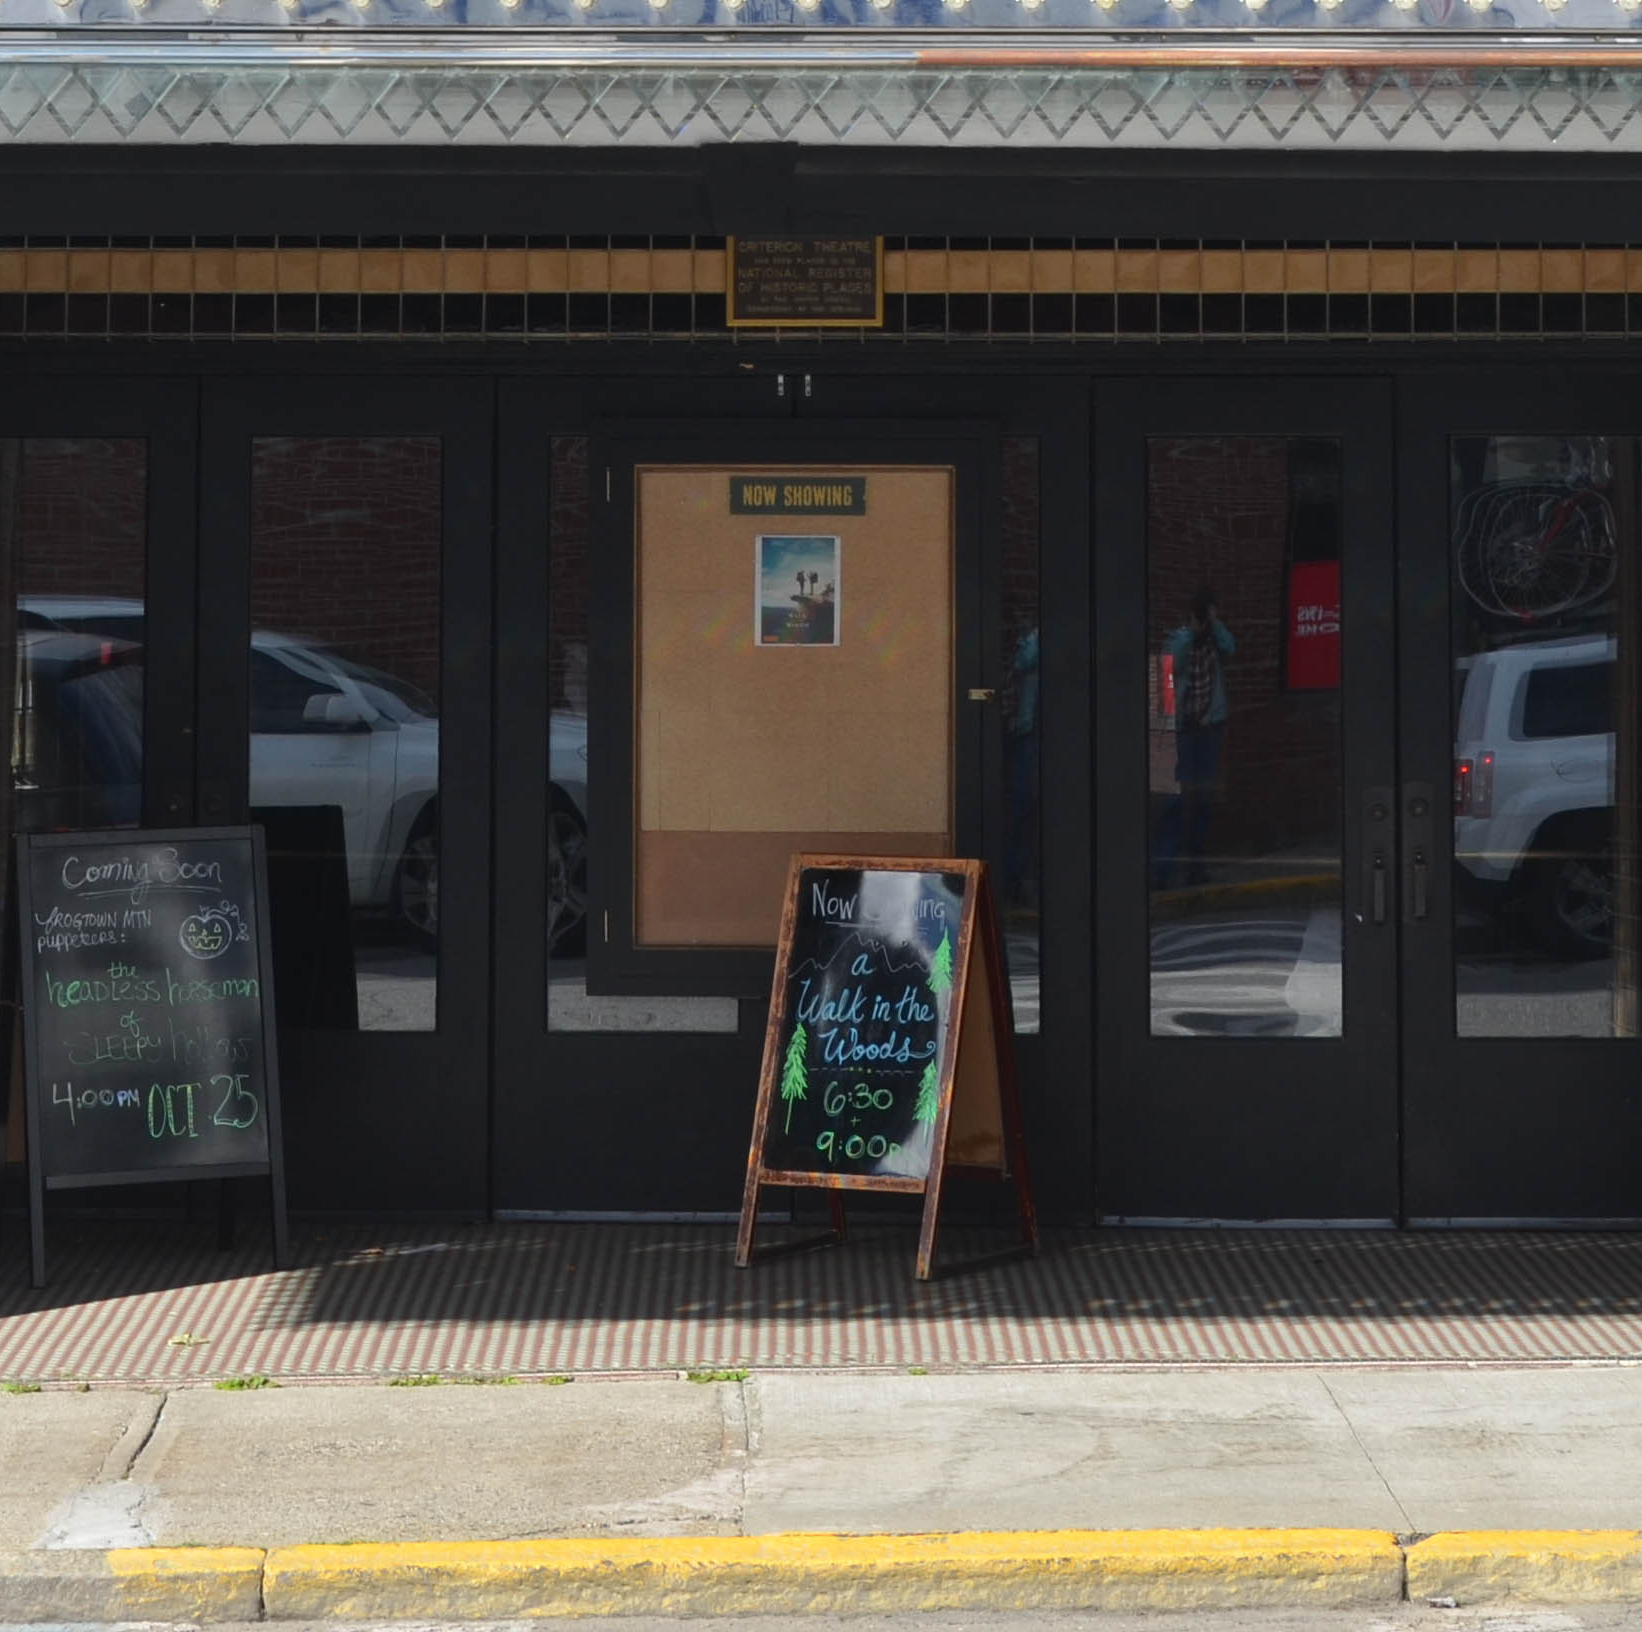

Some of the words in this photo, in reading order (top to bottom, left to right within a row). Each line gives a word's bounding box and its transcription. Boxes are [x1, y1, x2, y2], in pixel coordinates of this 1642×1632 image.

[739, 240, 803, 254] CRITERION
[813, 240, 872, 254] THEATRE
[738, 267, 798, 279] NATIONAL
[808, 267, 872, 279] REGISTER
[739, 282, 754, 294] OF
[760, 282, 817, 294] HISTORIC
[822, 282, 872, 294] PLACES
[743, 485, 776, 506] NOW
[784, 485, 853, 507] SHOWING
[62, 856, 151, 904] Coming
[159, 848, 222, 883] Soon
[812, 879, 857, 917] Now
[108, 962, 139, 979] the
[850, 952, 873, 976] a
[797, 979, 864, 1023] Walk
[872, 995, 893, 1020] in
[895, 987, 935, 1022] the
[119, 1010, 141, 1037] of
[818, 1028, 937, 1065] Woods
[148, 1081, 203, 1138] OCT
[208, 1074, 259, 1128] 25
[823, 1081, 893, 1117] 6:30
